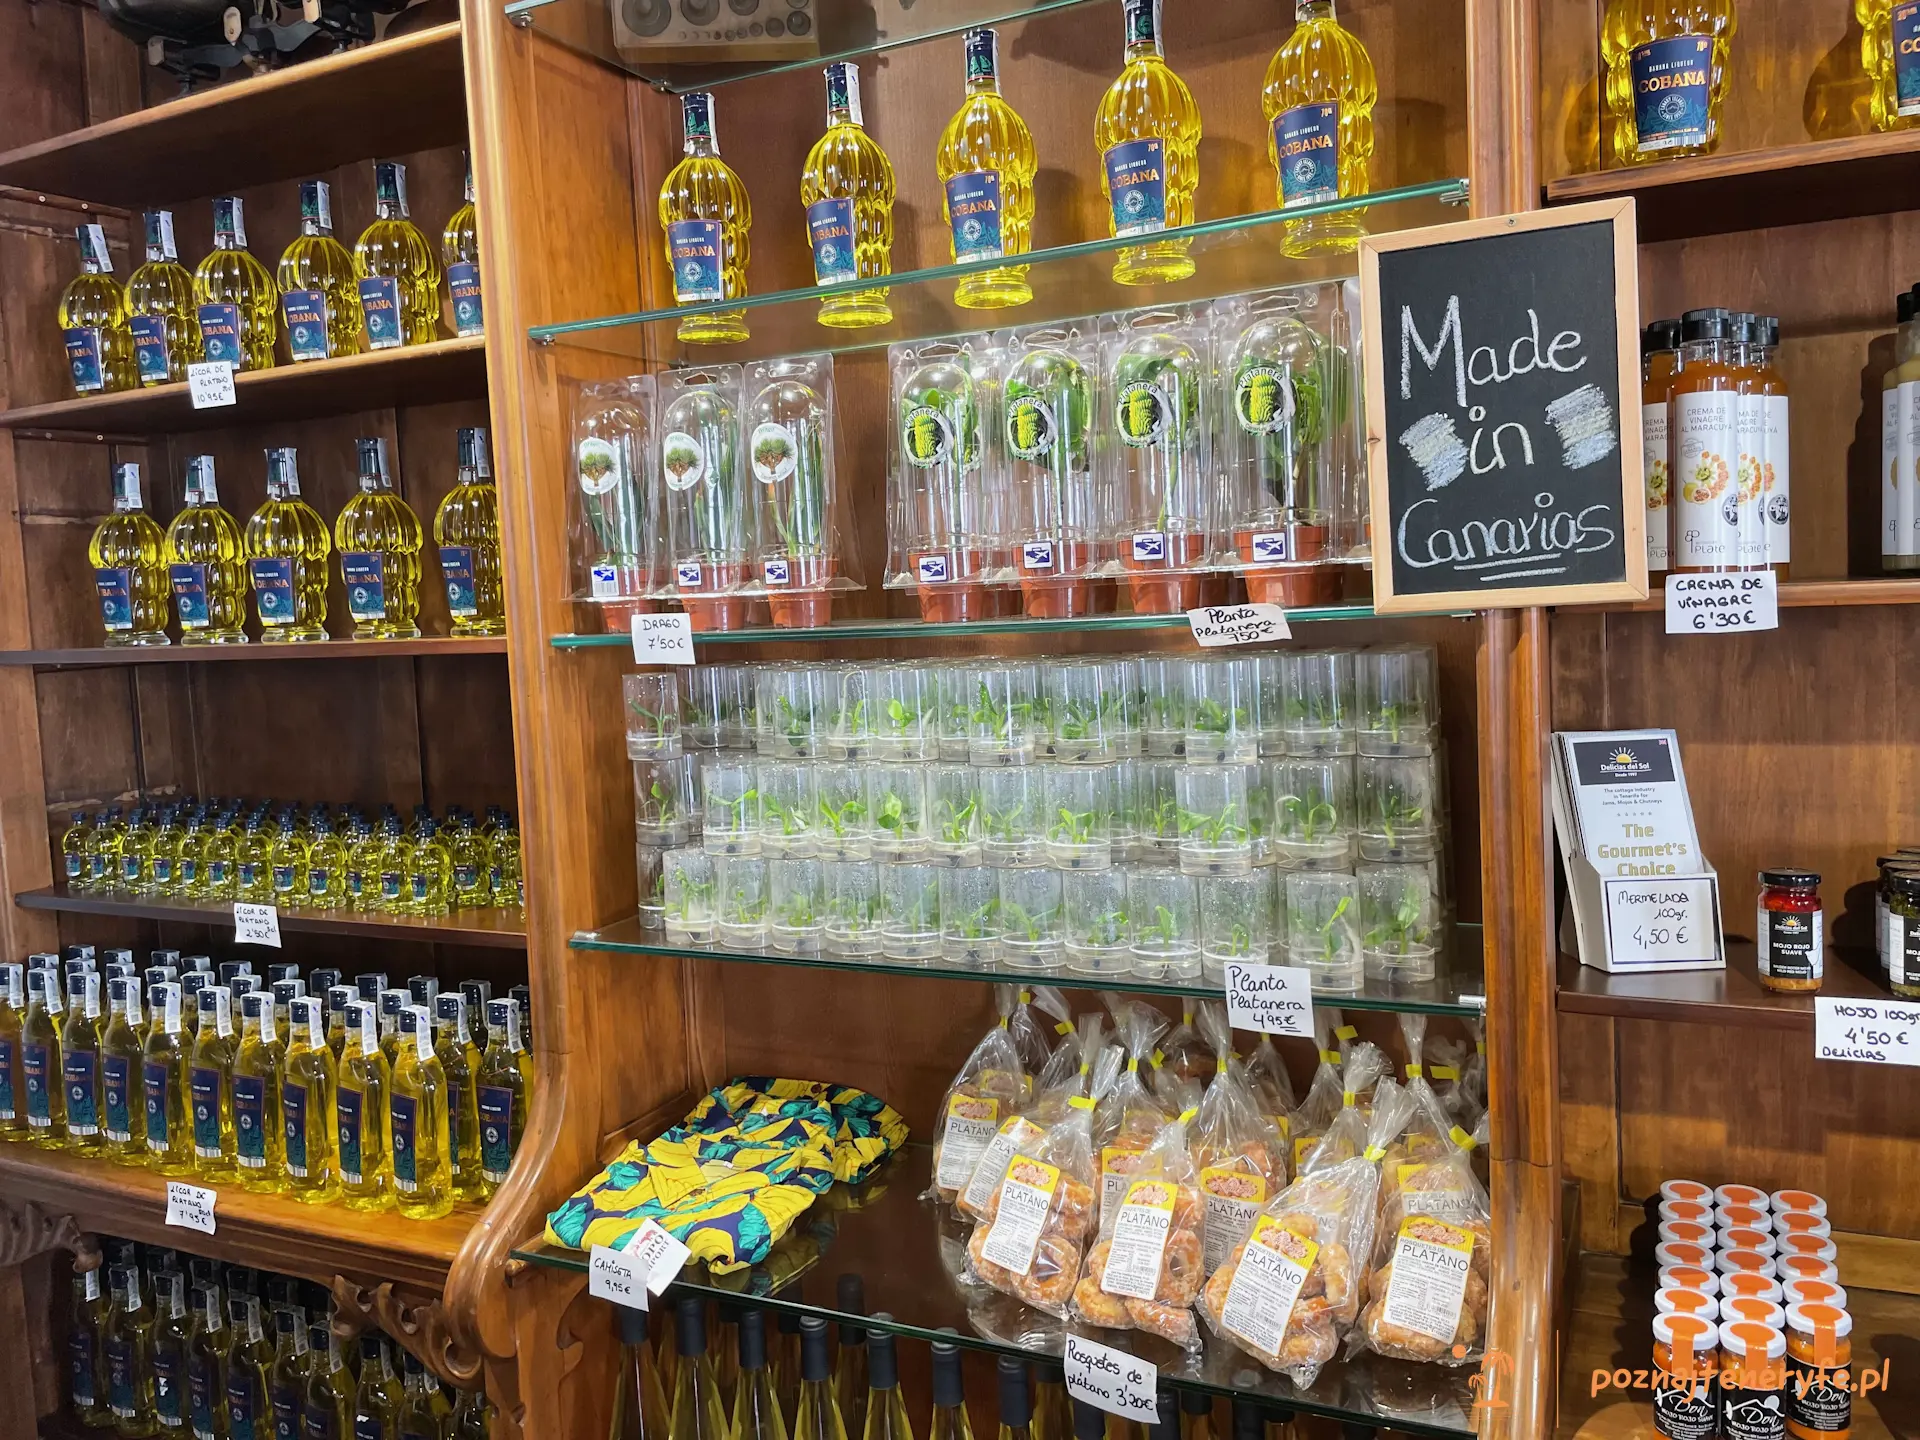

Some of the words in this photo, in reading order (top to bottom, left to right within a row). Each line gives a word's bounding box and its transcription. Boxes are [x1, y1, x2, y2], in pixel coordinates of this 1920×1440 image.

[1638, 70, 1706, 94] COBANA
[1280, 134, 1333, 159] COBANA
[1111, 168, 1160, 190] COBANA
[951, 199, 996, 217] COBANA
[673, 245, 715, 258] COBANA
[1400, 294, 1588, 408] Made
[1687, 408, 1714, 416] CREMA
[1716, 407, 1727, 415] DE
[1689, 415, 1724, 424] VINAGRE
[1645, 418, 1664, 426] REMA
[1468, 405, 1535, 476] in
[1397, 492, 1616, 569] Canarias
[1676, 579, 1735, 591] CREMA
[1741, 578, 1763, 590] DE
[1678, 594, 1752, 609] VINAGRE
[642, 618, 681, 631] DRAGO
[1205, 607, 1259, 624] Planta
[1600, 763, 1627, 771] Delicias
[1638, 762, 1650, 770] Sol
[1622, 824, 1654, 838] The
[1597, 843, 1687, 859] Gourmet's
[1617, 861, 1676, 876] Choice
[1618, 890, 1690, 905] MERMELADA
[1676, 926, 1689, 944] €
[1228, 965, 1288, 992] Planta
[1229, 989, 1305, 1011] Platanera
[1896, 1032, 1909, 1045] €
[1005, 1186, 1048, 1211] PLATANO
[1408, 1198, 1472, 1211] PLATANO
[1120, 1211, 1169, 1229] PLATANO
[1246, 1248, 1302, 1285] PLATANO
[1402, 1244, 1469, 1272] PLATANO
[1068, 1339, 1120, 1375] Rosquetes
[1127, 1369, 1142, 1385] de
[1741, 1406, 1779, 1428] Don
